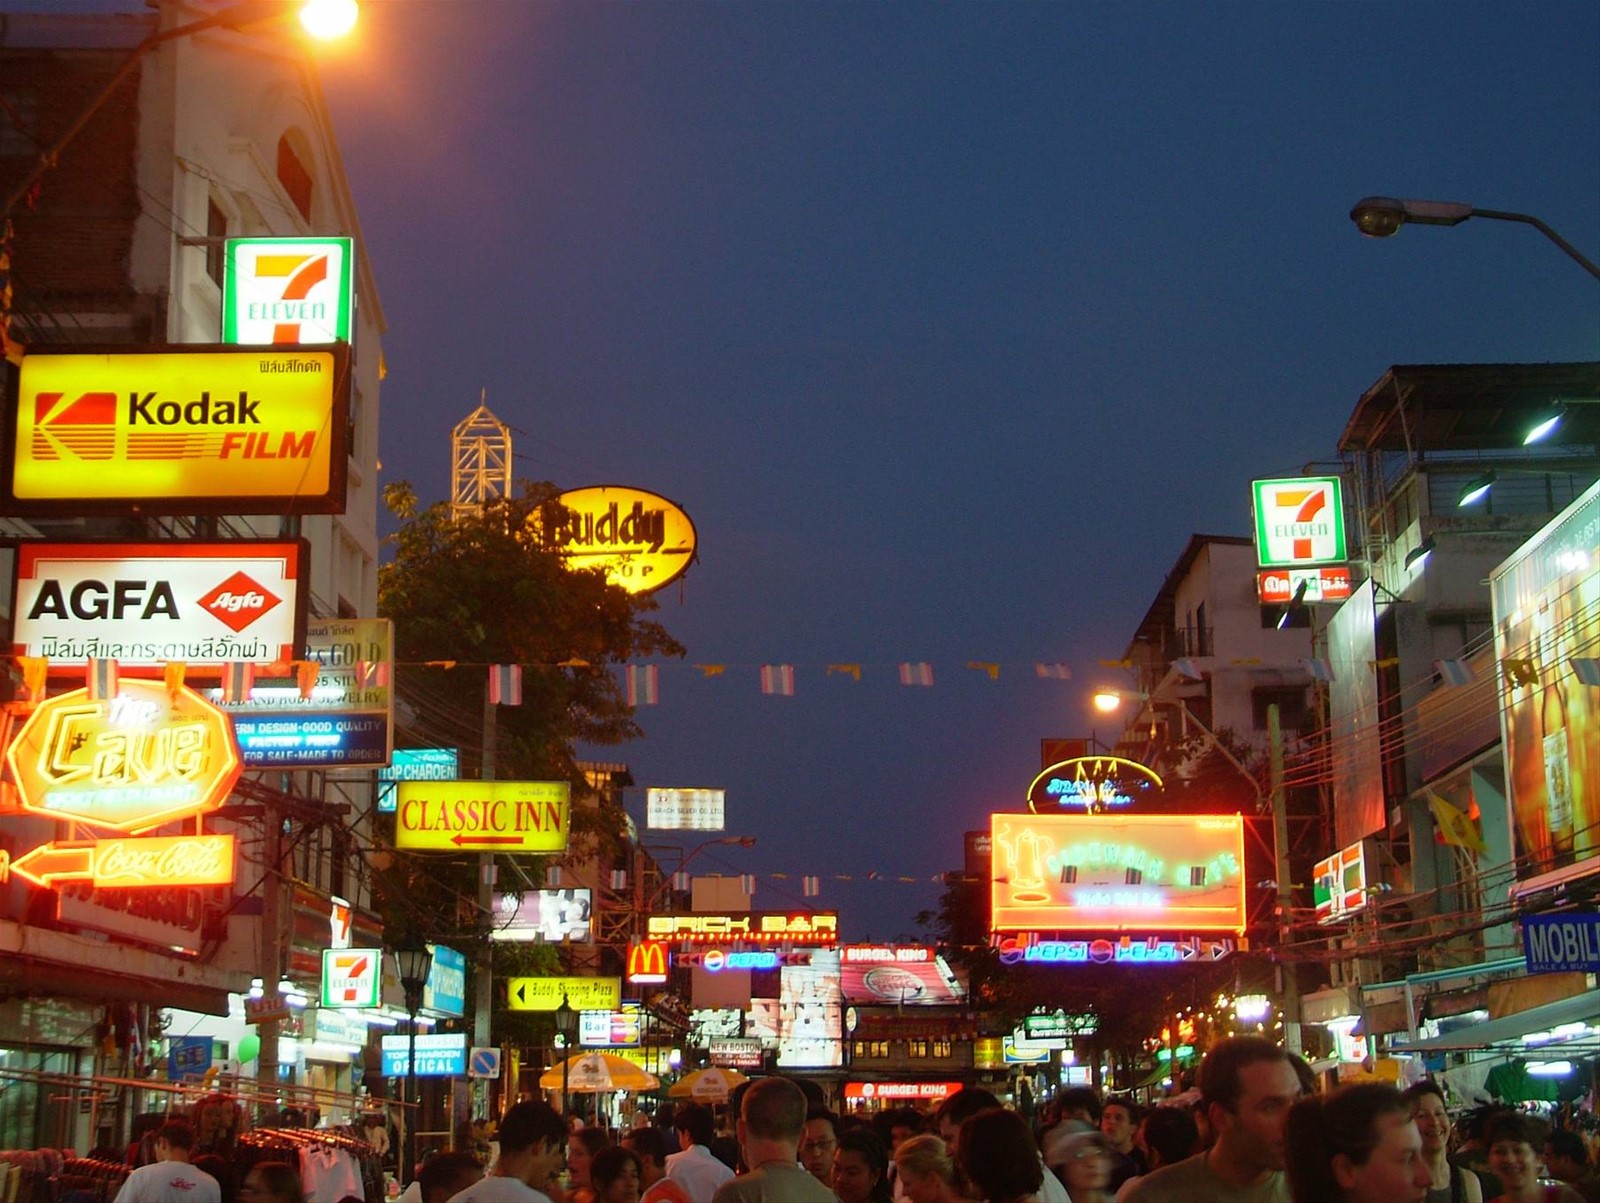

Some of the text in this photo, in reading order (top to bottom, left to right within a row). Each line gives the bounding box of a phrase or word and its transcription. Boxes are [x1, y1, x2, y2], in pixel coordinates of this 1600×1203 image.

[128, 391, 261, 426] Kodak
[218, 431, 317, 459] FILM
[1275, 523, 1328, 537] ELEVEN
[28, 580, 181, 620] AGFA
[209, 591, 264, 613] Agfa
[331, 643, 381, 666] GOLD
[336, 720, 382, 732] QUALITY
[243, 751, 263, 762] FOR
[332, 750, 345, 759] TO
[401, 799, 563, 832] CLASSIC INN
[96, 838, 224, 880] Coca-Cola
[1176, 852, 1241, 885] CFE
[649, 916, 750, 933] BRICK
[727, 953, 776, 967] PEPSI
[896, 948, 928, 961] KING
[1027, 943, 1177, 960] PEPSI PEPSI
[532, 982, 555, 996] Buddy
[593, 982, 613, 996] Plaza
[711, 1042, 760, 1052] NEW BOSTON
[877, 1084, 947, 1095] BURGER KING
